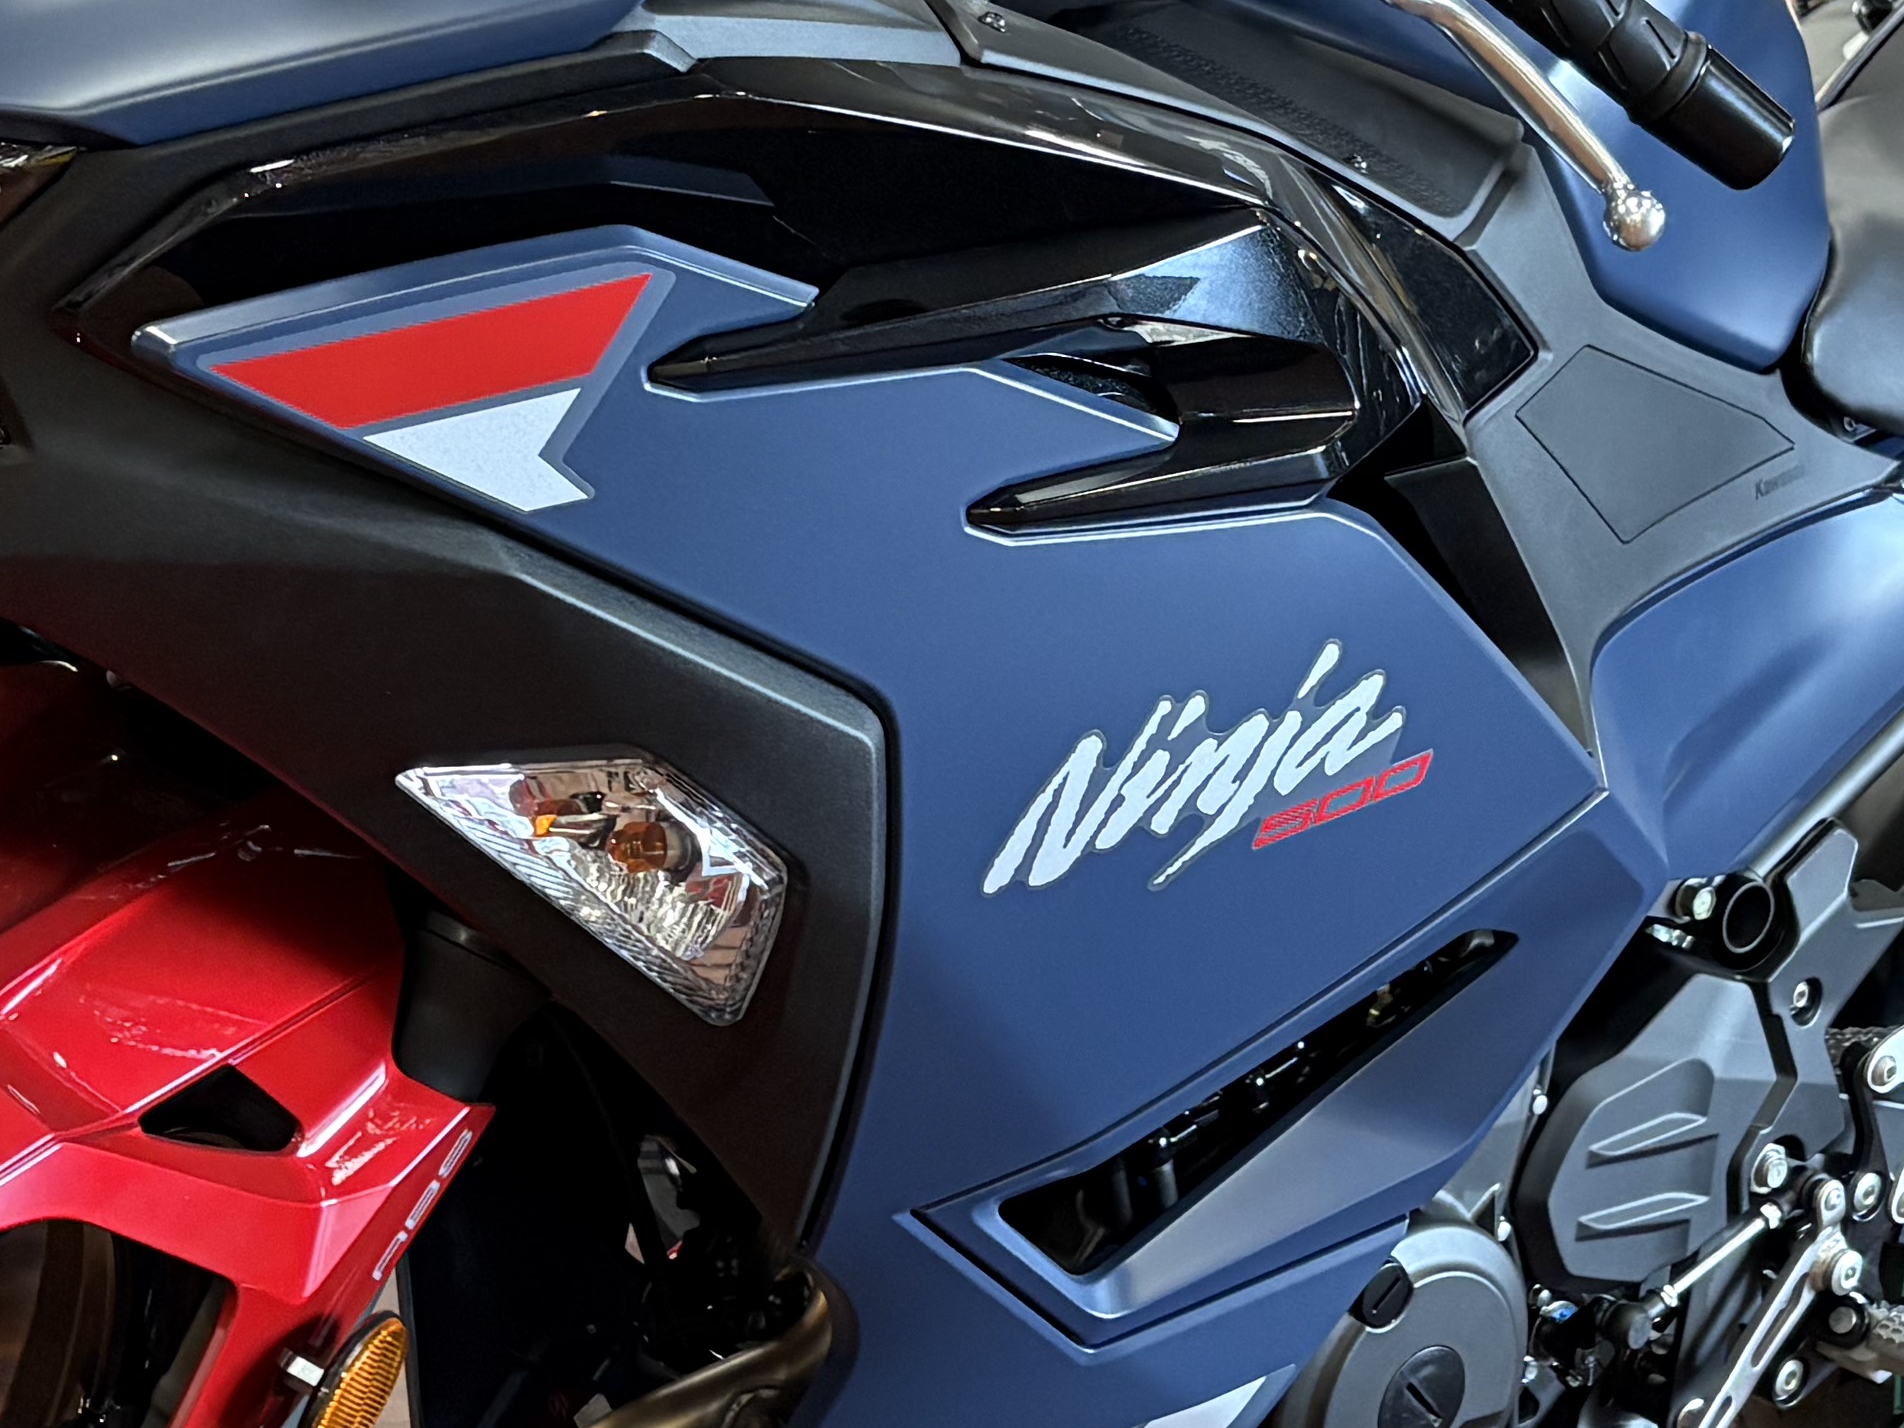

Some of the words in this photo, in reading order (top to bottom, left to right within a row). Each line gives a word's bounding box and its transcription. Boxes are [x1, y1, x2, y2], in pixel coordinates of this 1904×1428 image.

[982, 638, 1405, 895] Ninja
[1251, 748, 1434, 851] 500
[371, 1128, 473, 1282] ABS
